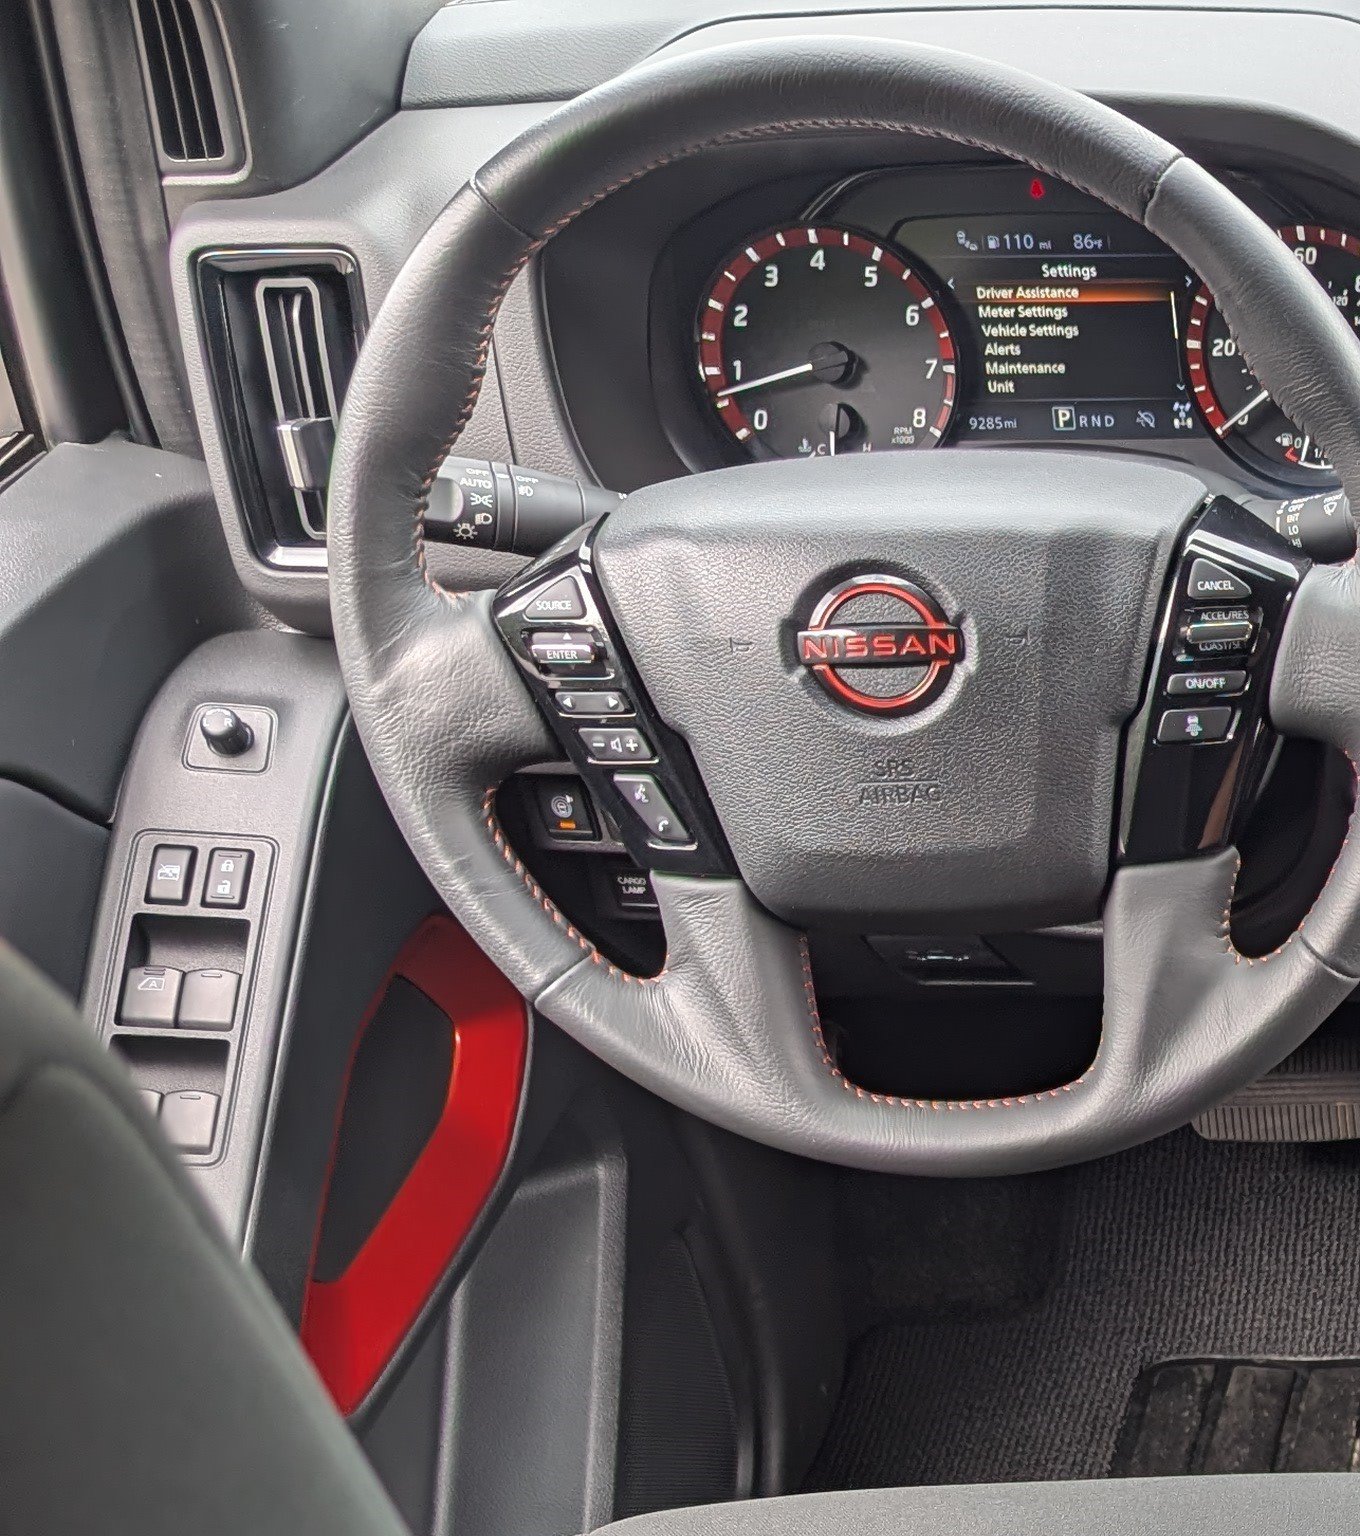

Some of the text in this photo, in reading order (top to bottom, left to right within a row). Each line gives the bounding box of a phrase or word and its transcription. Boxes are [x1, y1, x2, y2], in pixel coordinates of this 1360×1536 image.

[1004, 233, 1034, 250] 110
[810, 249, 826, 271] 4
[1294, 247, 1317, 265] 60
[764, 266, 779, 287] 3
[864, 266, 878, 287] 5
[1041, 263, 1098, 280] Settings
[976, 286, 1080, 299] Driver Assistance
[733, 304, 748, 327] 2
[905, 304, 920, 326] 6
[978, 305, 1068, 320] Meter Settings
[982, 324, 1080, 339] Vehicle Settings
[984, 343, 1021, 356] Alerts
[1212, 339, 1236, 357] 20
[733, 360, 742, 381] 1
[925, 358, 938, 379] 7
[985, 361, 1066, 375] Maintenance
[987, 380, 1015, 393] Unit
[754, 409, 768, 430] 0
[913, 408, 926, 428] 8
[1080, 415, 1088, 428] R
[1091, 415, 1101, 427] N
[1105, 415, 1115, 427] D
[893, 426, 912, 435] RPM
[817, 443, 826, 455] C
[862, 443, 871, 453] H
[466, 468, 489, 476] OFF
[516, 475, 539, 483] OFF
[460, 477, 493, 489] AUTO
[1288, 525, 1299, 536] LO
[1197, 580, 1235, 591] CANCEL
[536, 600, 572, 611] SOURCE
[1200, 610, 1250, 621] ACCEL/RES
[803, 634, 956, 659] NISSAN
[546, 649, 578, 660] ENTER
[1185, 677, 1226, 689] ON/OFF
[224, 718, 233, 727] R
[874, 760, 916, 777] SRS
[859, 784, 942, 804] AIRBAG
